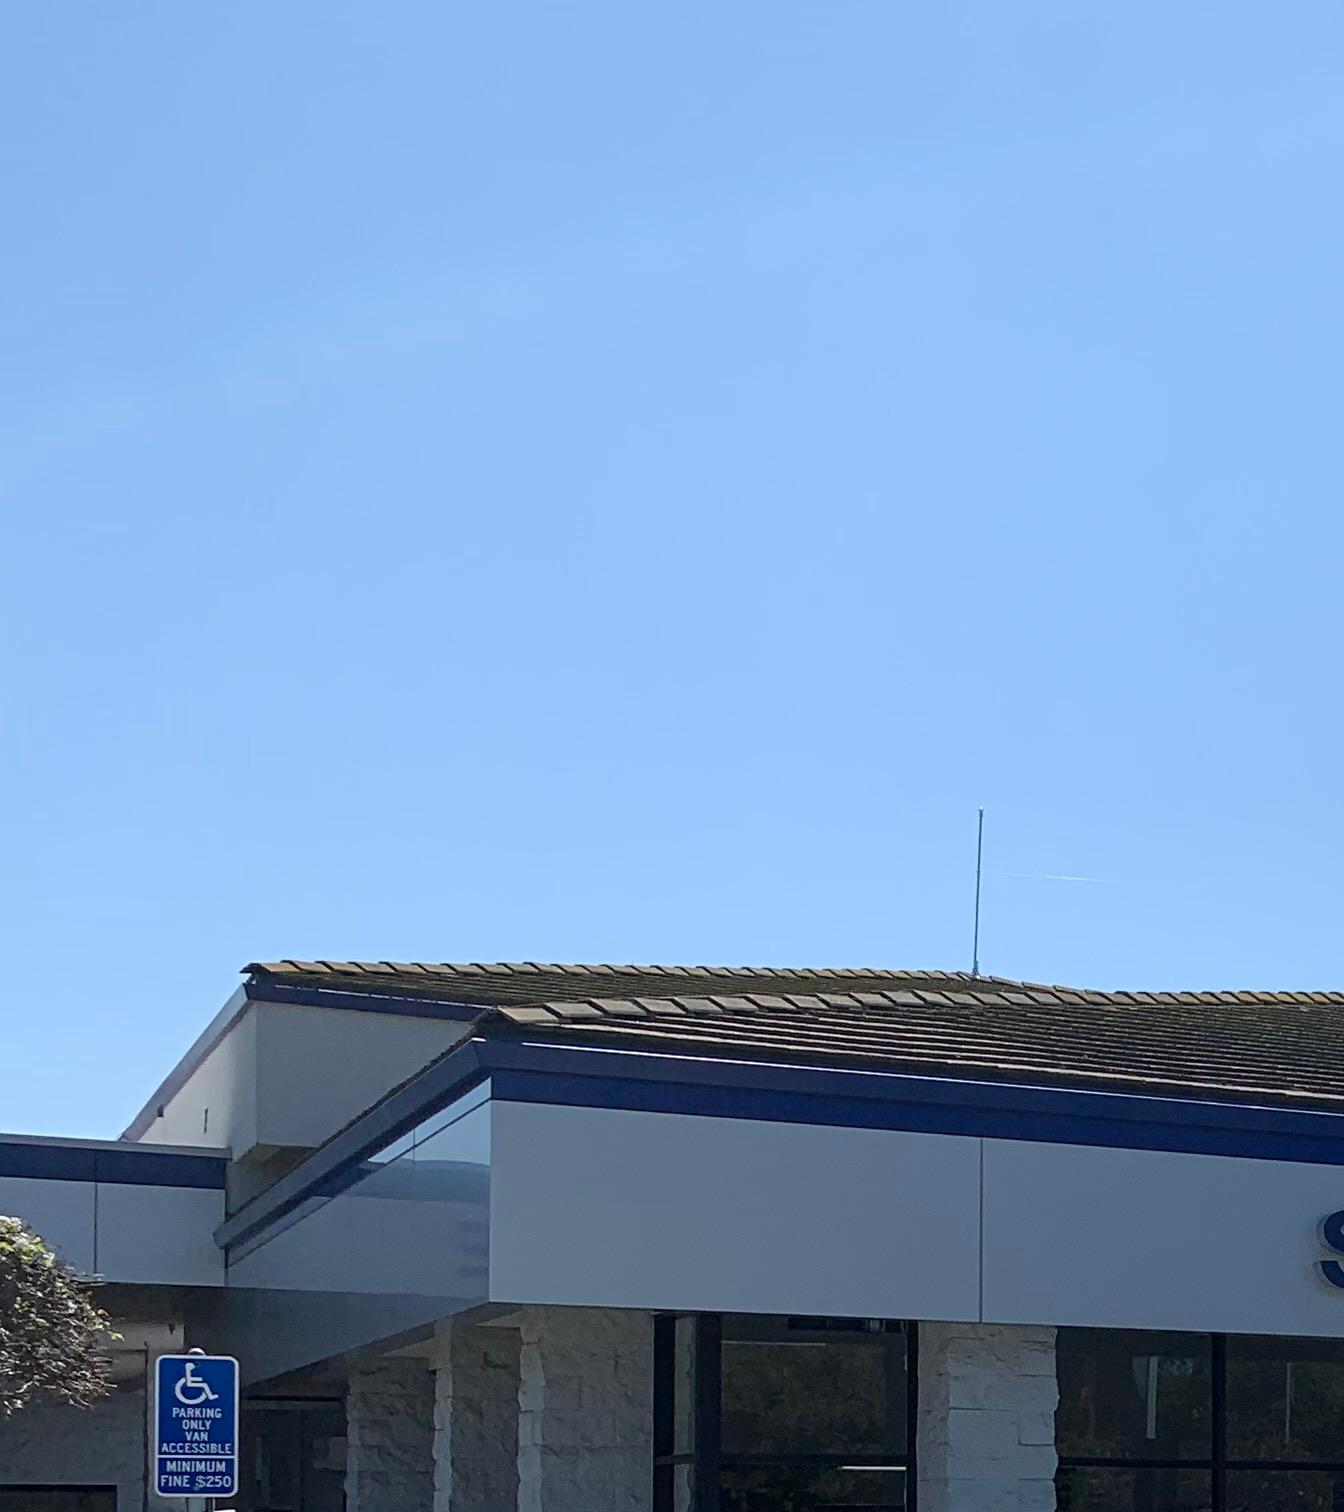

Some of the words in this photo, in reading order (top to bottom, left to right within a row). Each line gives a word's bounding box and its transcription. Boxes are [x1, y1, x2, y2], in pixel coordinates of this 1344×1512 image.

[172, 1407, 222, 1419] PARKING
[181, 1419, 212, 1430] ONLY
[185, 1431, 209, 1442] VAN
[161, 1443, 232, 1454] ACCESSIBLE
[166, 1460, 226, 1473] MINIMUM
[160, 1475, 191, 1487] FINE
[195, 1475, 232, 1488] $250
